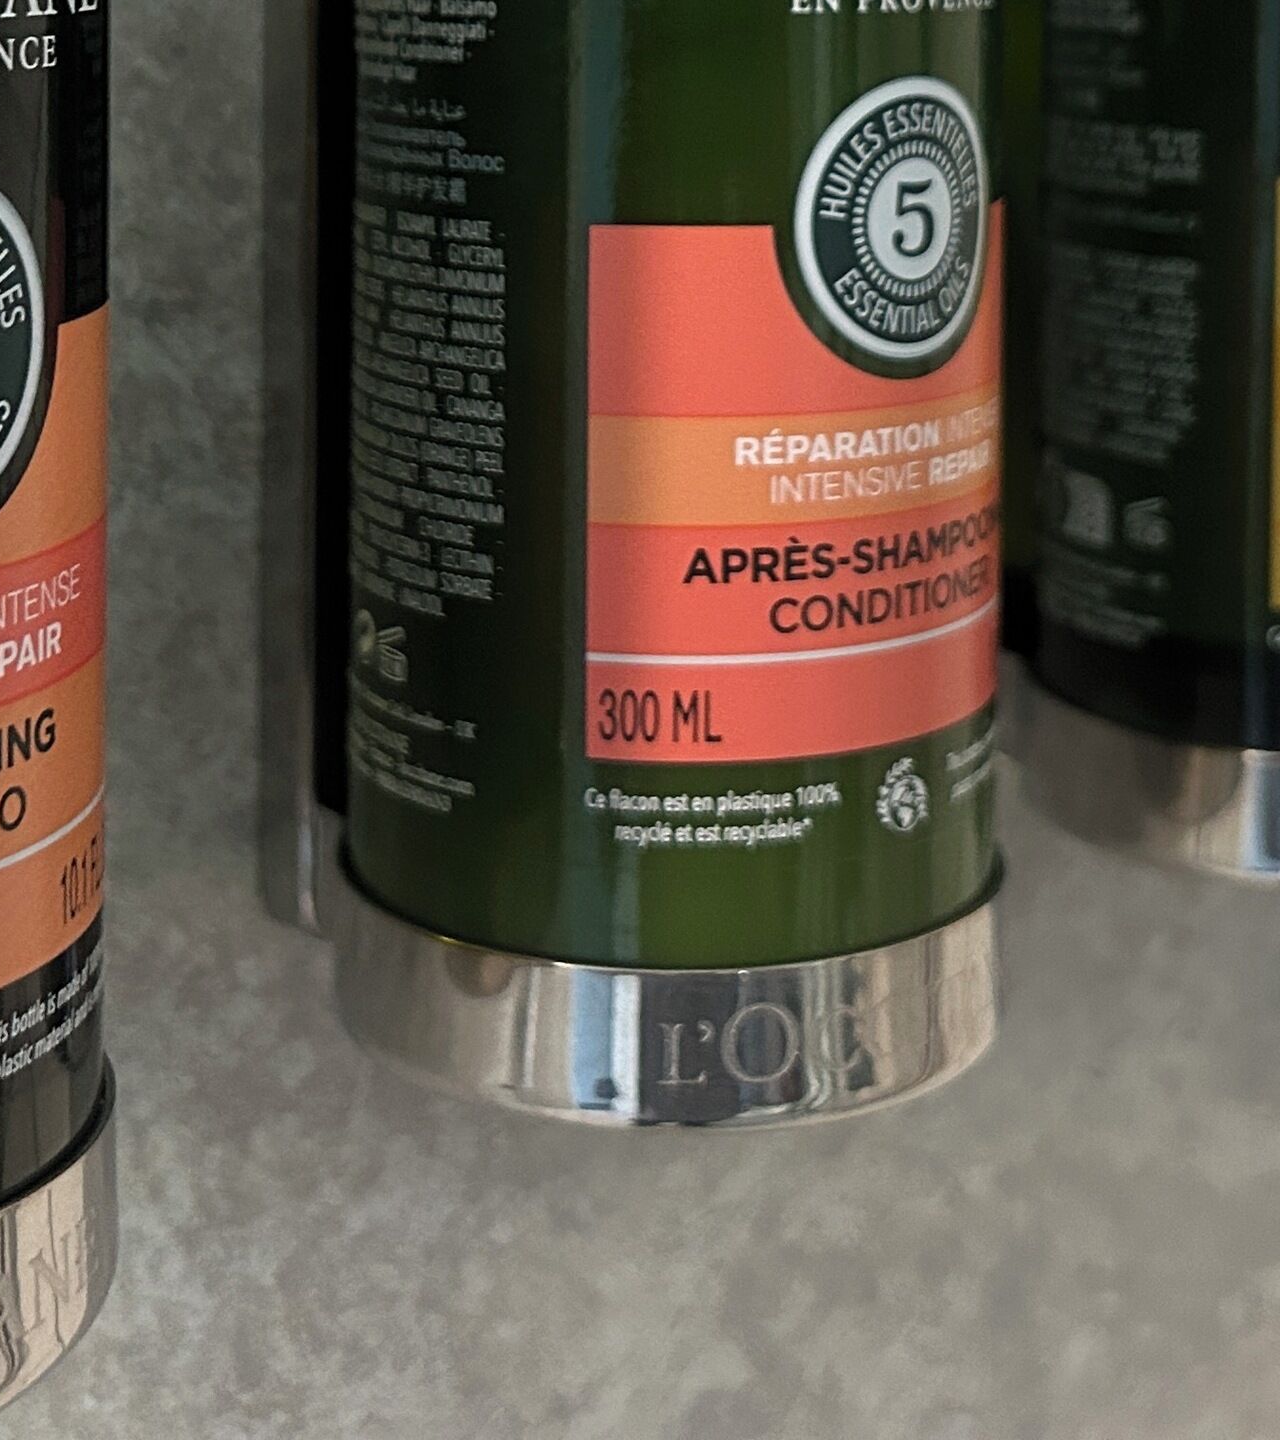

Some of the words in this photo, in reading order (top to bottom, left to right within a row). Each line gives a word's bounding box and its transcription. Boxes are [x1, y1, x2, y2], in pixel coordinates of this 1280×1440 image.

[819, 120, 885, 221] HUILES
[882, 101, 978, 208] ESSENTIELLES
[891, 178, 935, 257] 5
[832, 266, 942, 335] ESSENTIAL
[936, 255, 969, 314] OILS
[733, 420, 940, 467] RÉPARATION
[769, 459, 924, 505] INTENSIVE
[598, 687, 661, 743] 300
[672, 688, 723, 743] ML
[583, 786, 607, 810] Ce
[608, 786, 661, 813] flacon
[662, 792, 690, 813] est
[691, 794, 715, 812] en
[716, 788, 794, 818] plastique
[794, 780, 842, 808] 100%
[675, 822, 694, 843] et
[694, 822, 721, 843] est
[11, 998, 46, 1038] bottle
[46, 991, 57, 1016] is
